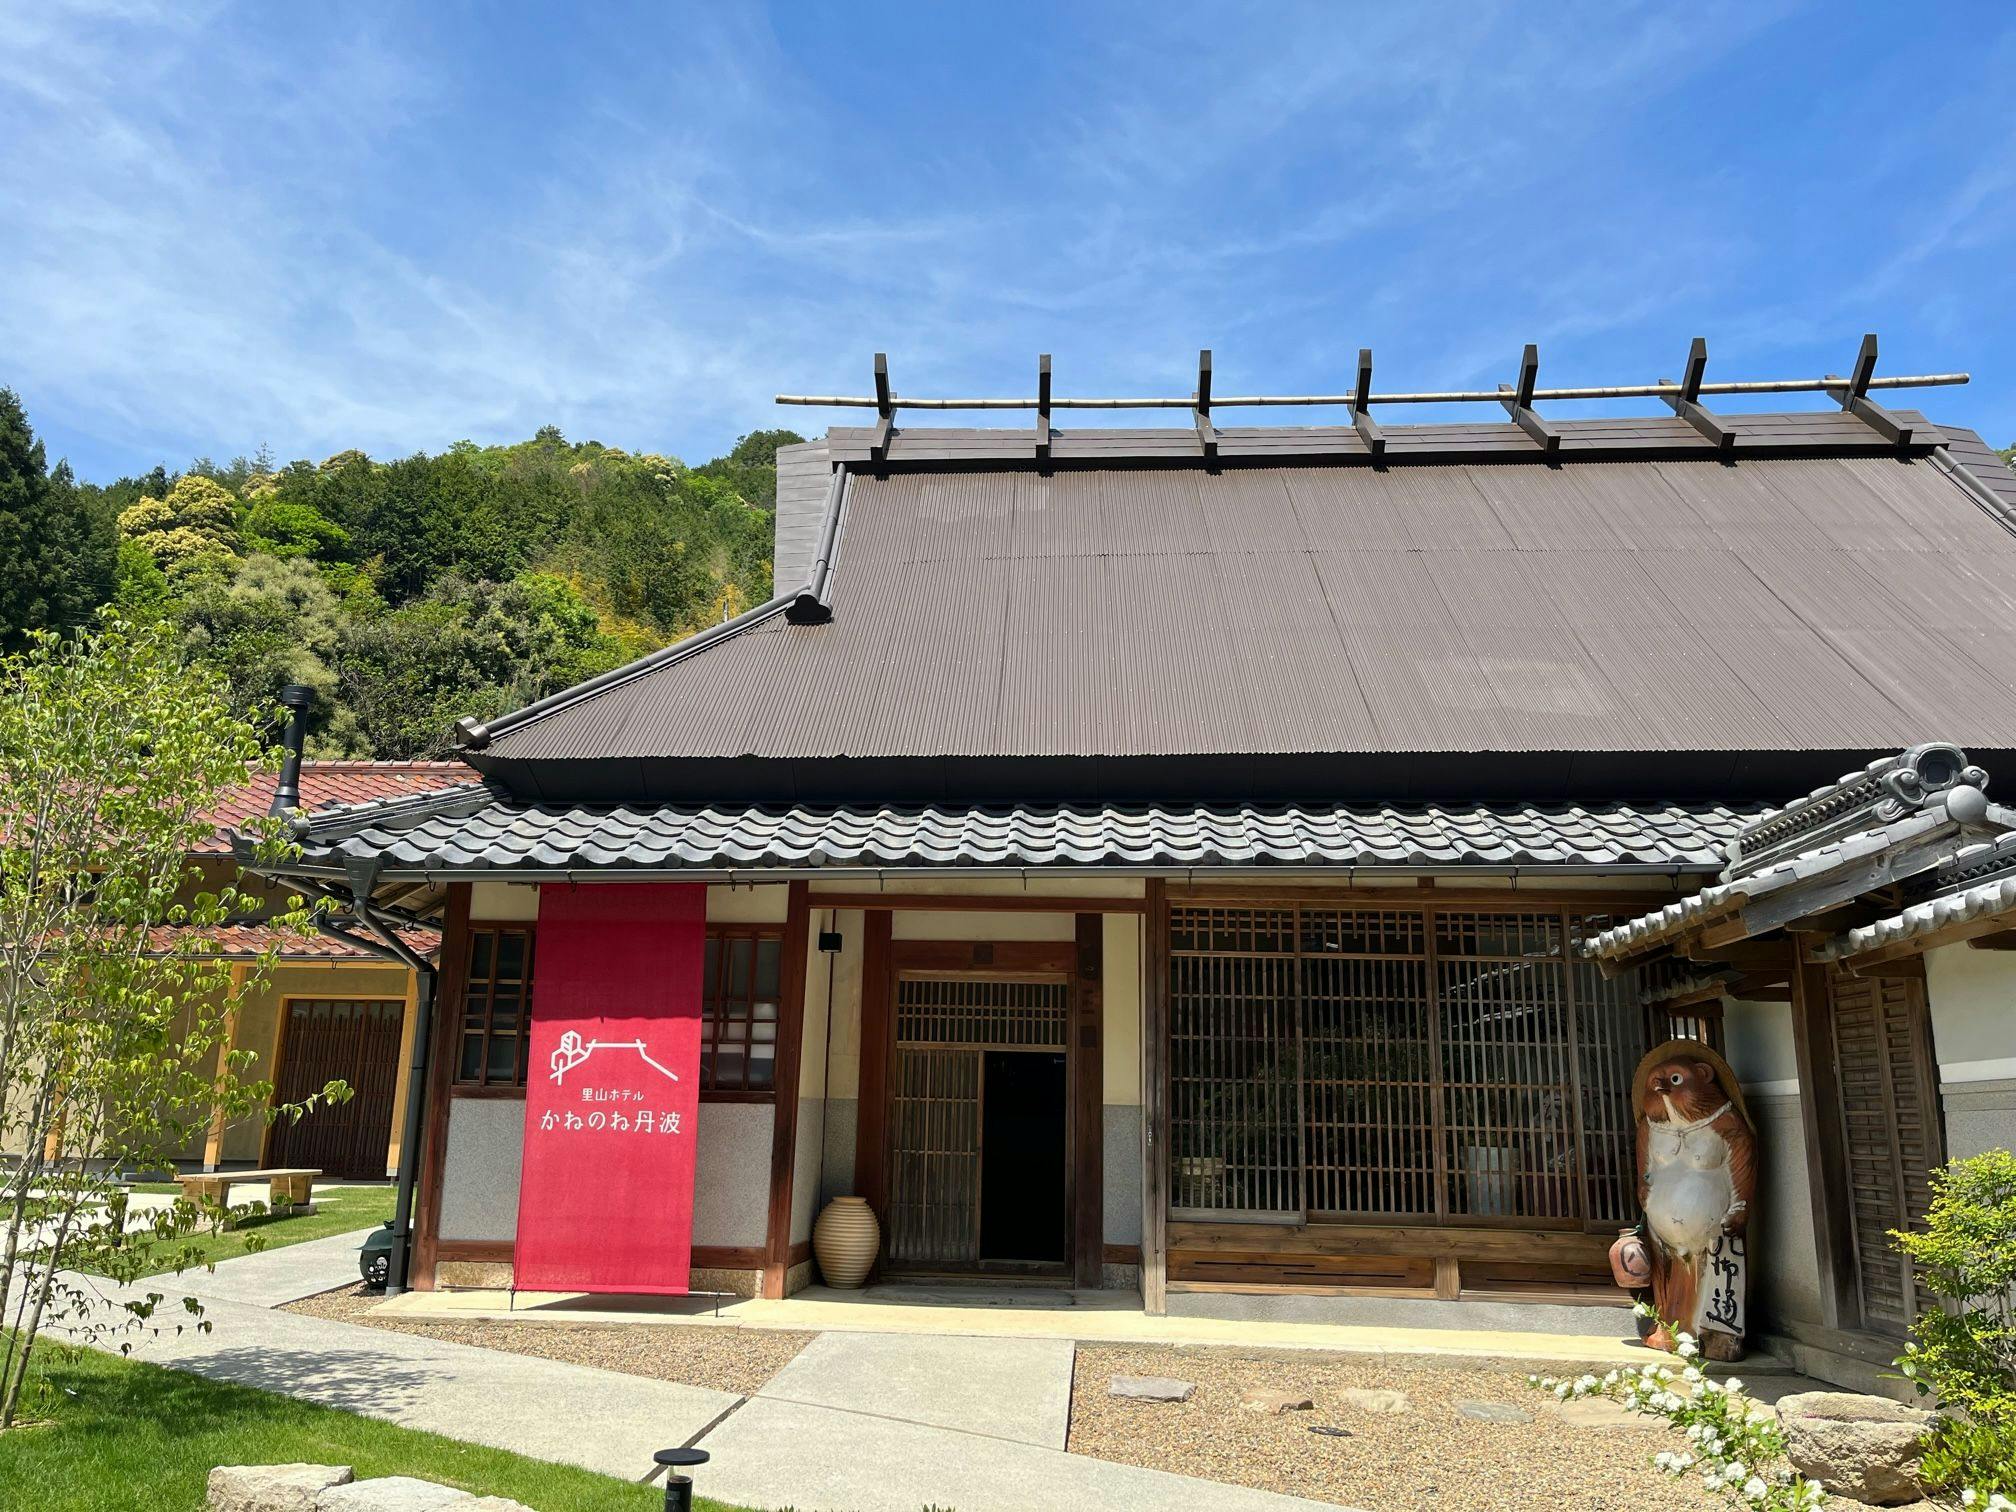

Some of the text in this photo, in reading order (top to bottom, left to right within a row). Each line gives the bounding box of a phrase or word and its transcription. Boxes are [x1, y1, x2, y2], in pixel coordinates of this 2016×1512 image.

[581, 1087, 645, 1102] 里山ホテル
[541, 1109, 681, 1134] かねのね丹波
